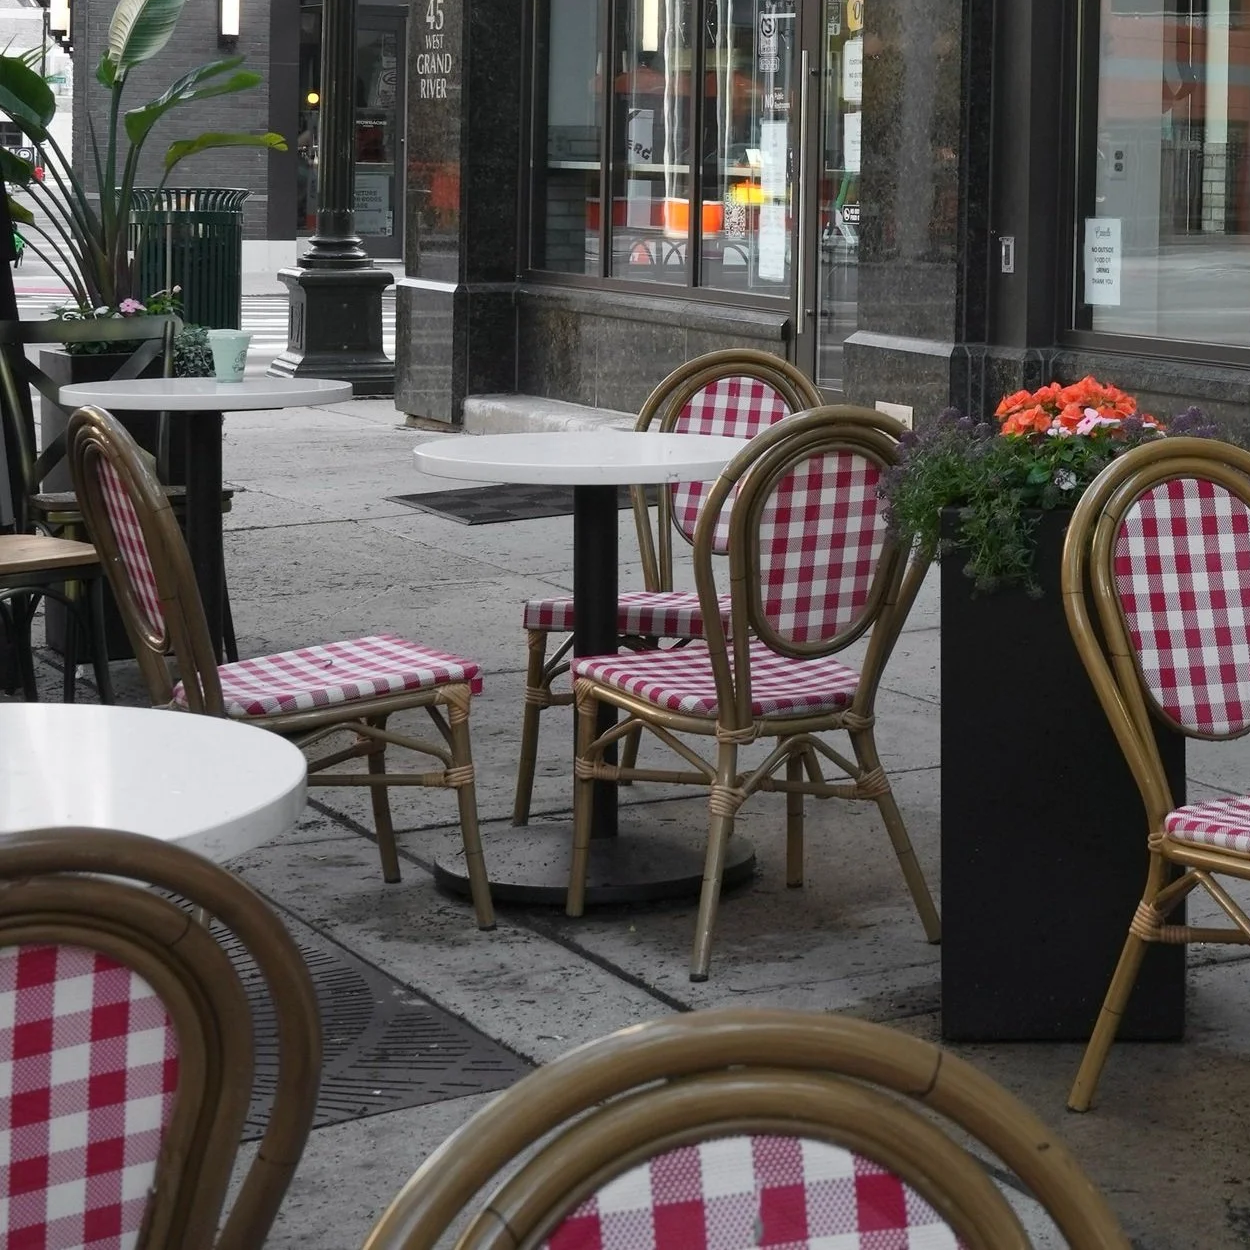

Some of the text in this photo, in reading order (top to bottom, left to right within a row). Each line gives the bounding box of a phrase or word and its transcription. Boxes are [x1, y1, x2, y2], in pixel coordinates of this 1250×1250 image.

[426, 34, 444, 49] WEST
[416, 53, 452, 75] GRAND
[420, 78, 447, 100] RIVER
[764, 93, 774, 109] NO
